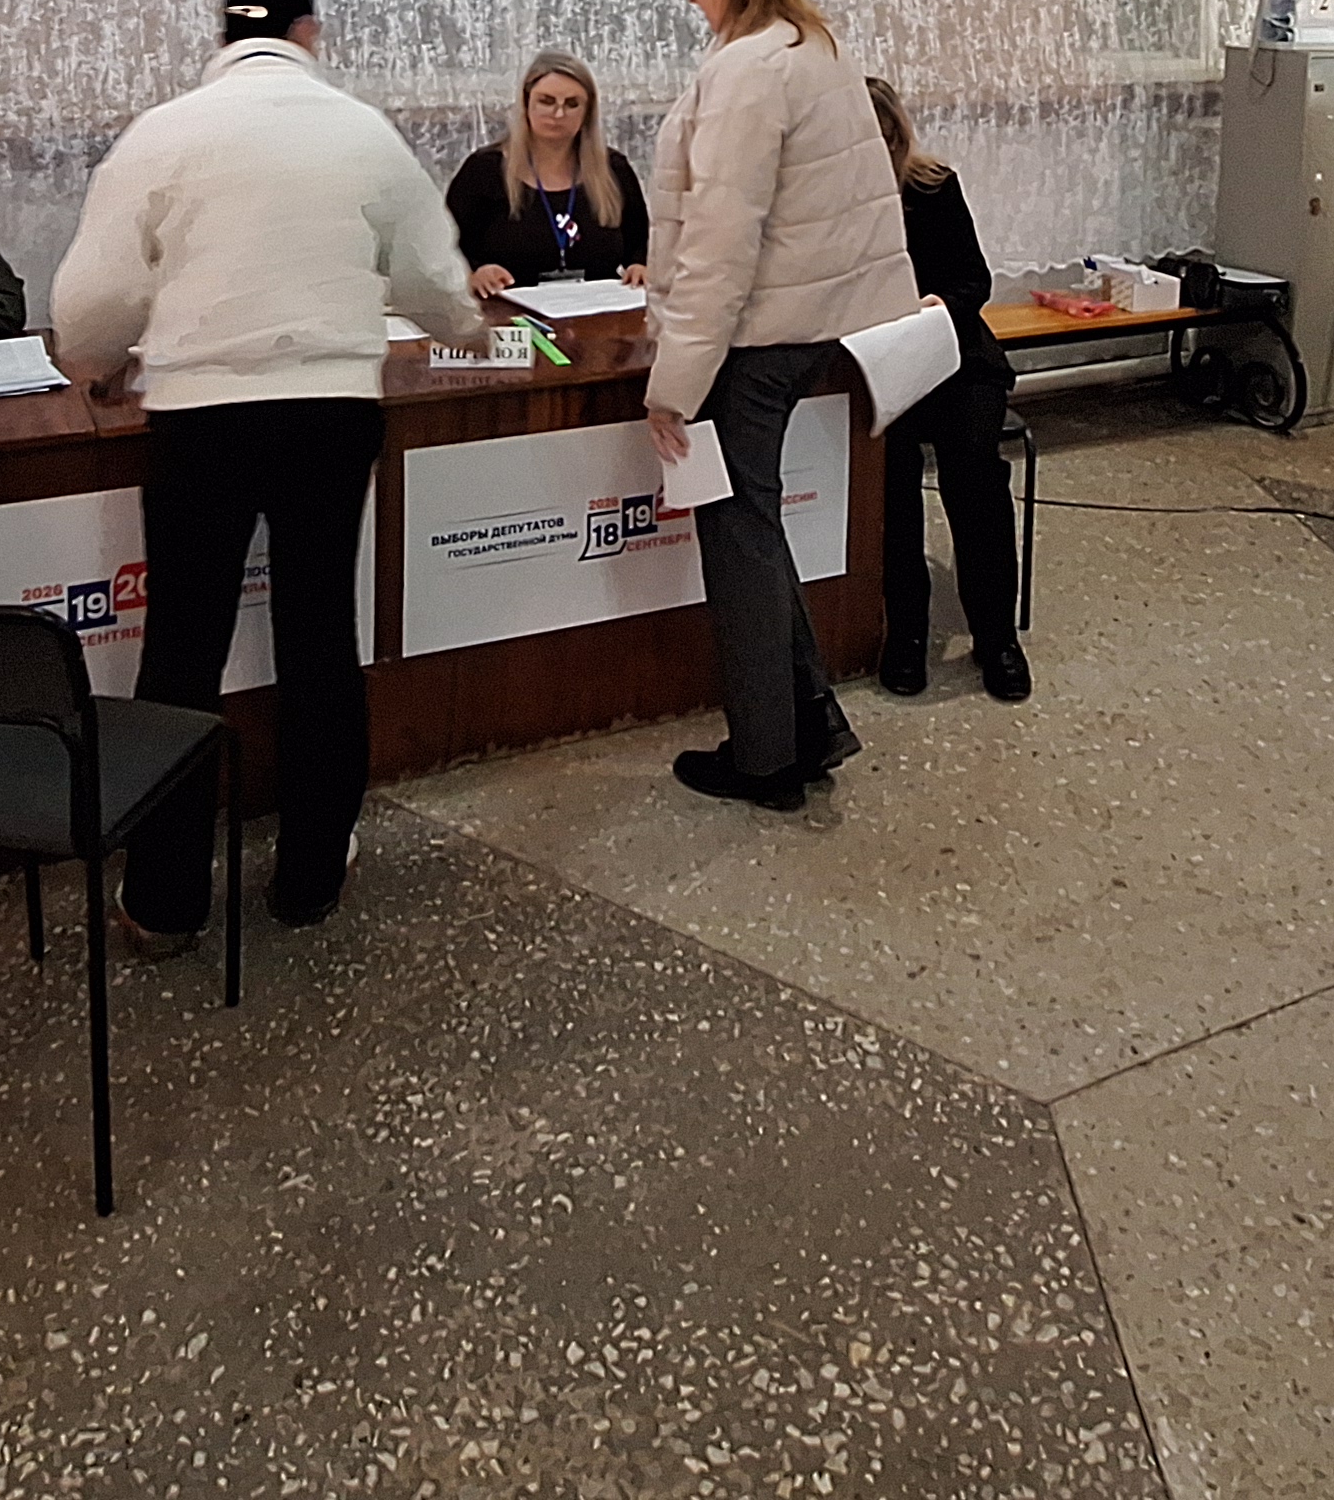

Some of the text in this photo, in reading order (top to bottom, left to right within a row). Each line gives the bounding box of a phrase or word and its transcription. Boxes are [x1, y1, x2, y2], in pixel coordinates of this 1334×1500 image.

[625, 504, 652, 530] 19
[431, 517, 565, 547] ВЫБОРЫ ДЕПУТАТОВ
[592, 522, 619, 548] 18
[448, 536, 546, 558] ГОСУДАРСТВЕННОЙ
[21, 583, 63, 601] 2026
[117, 571, 147, 601] 2
[71, 592, 108, 622] 19
[79, 626, 144, 647] СЕНТЯБ
